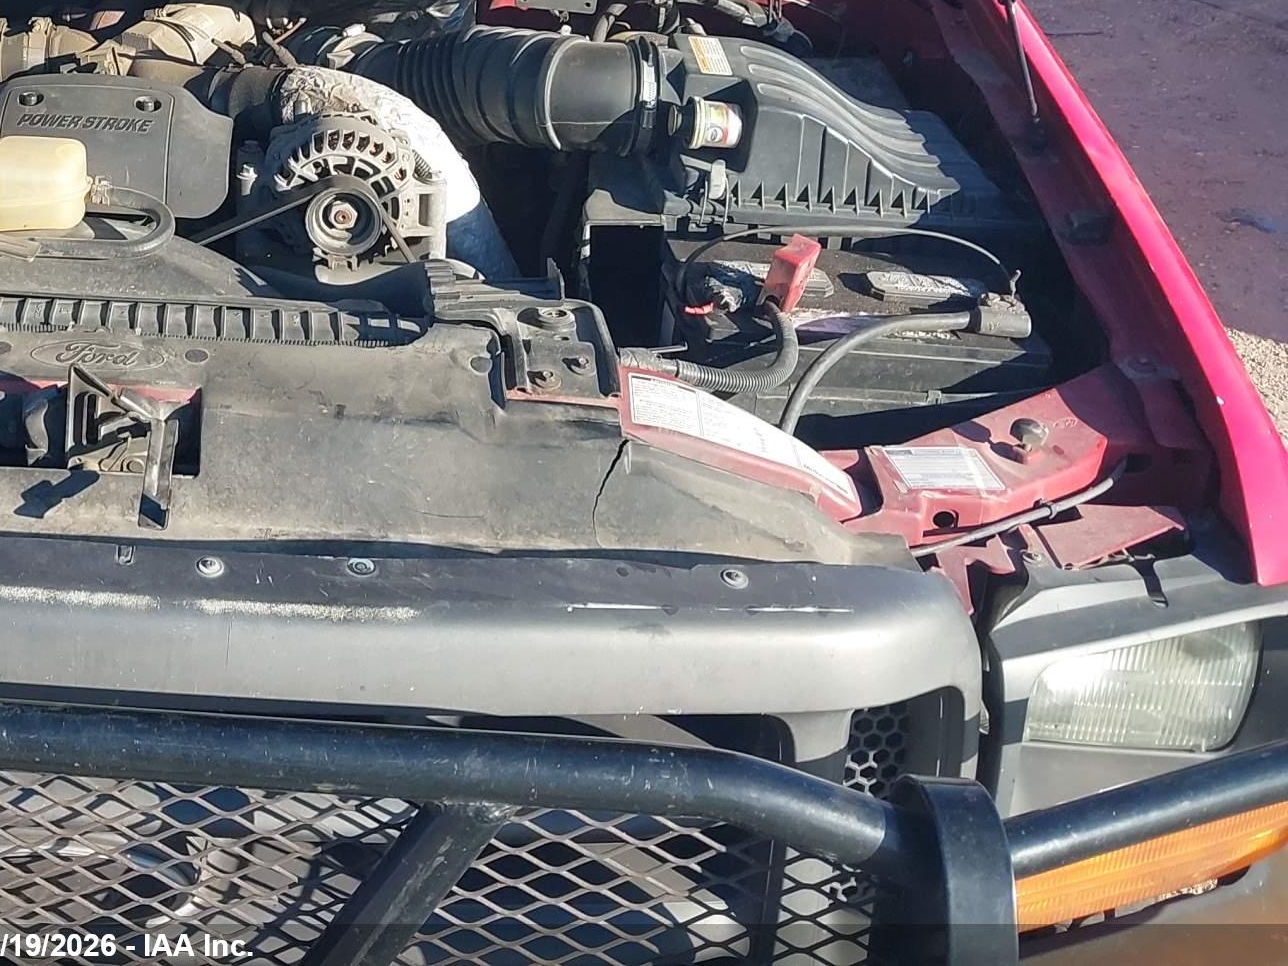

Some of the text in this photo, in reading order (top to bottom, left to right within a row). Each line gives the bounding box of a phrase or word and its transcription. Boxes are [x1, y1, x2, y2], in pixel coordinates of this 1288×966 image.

[16, 112, 154, 133] POWER STROKE
[55, 341, 140, 366] Ford
